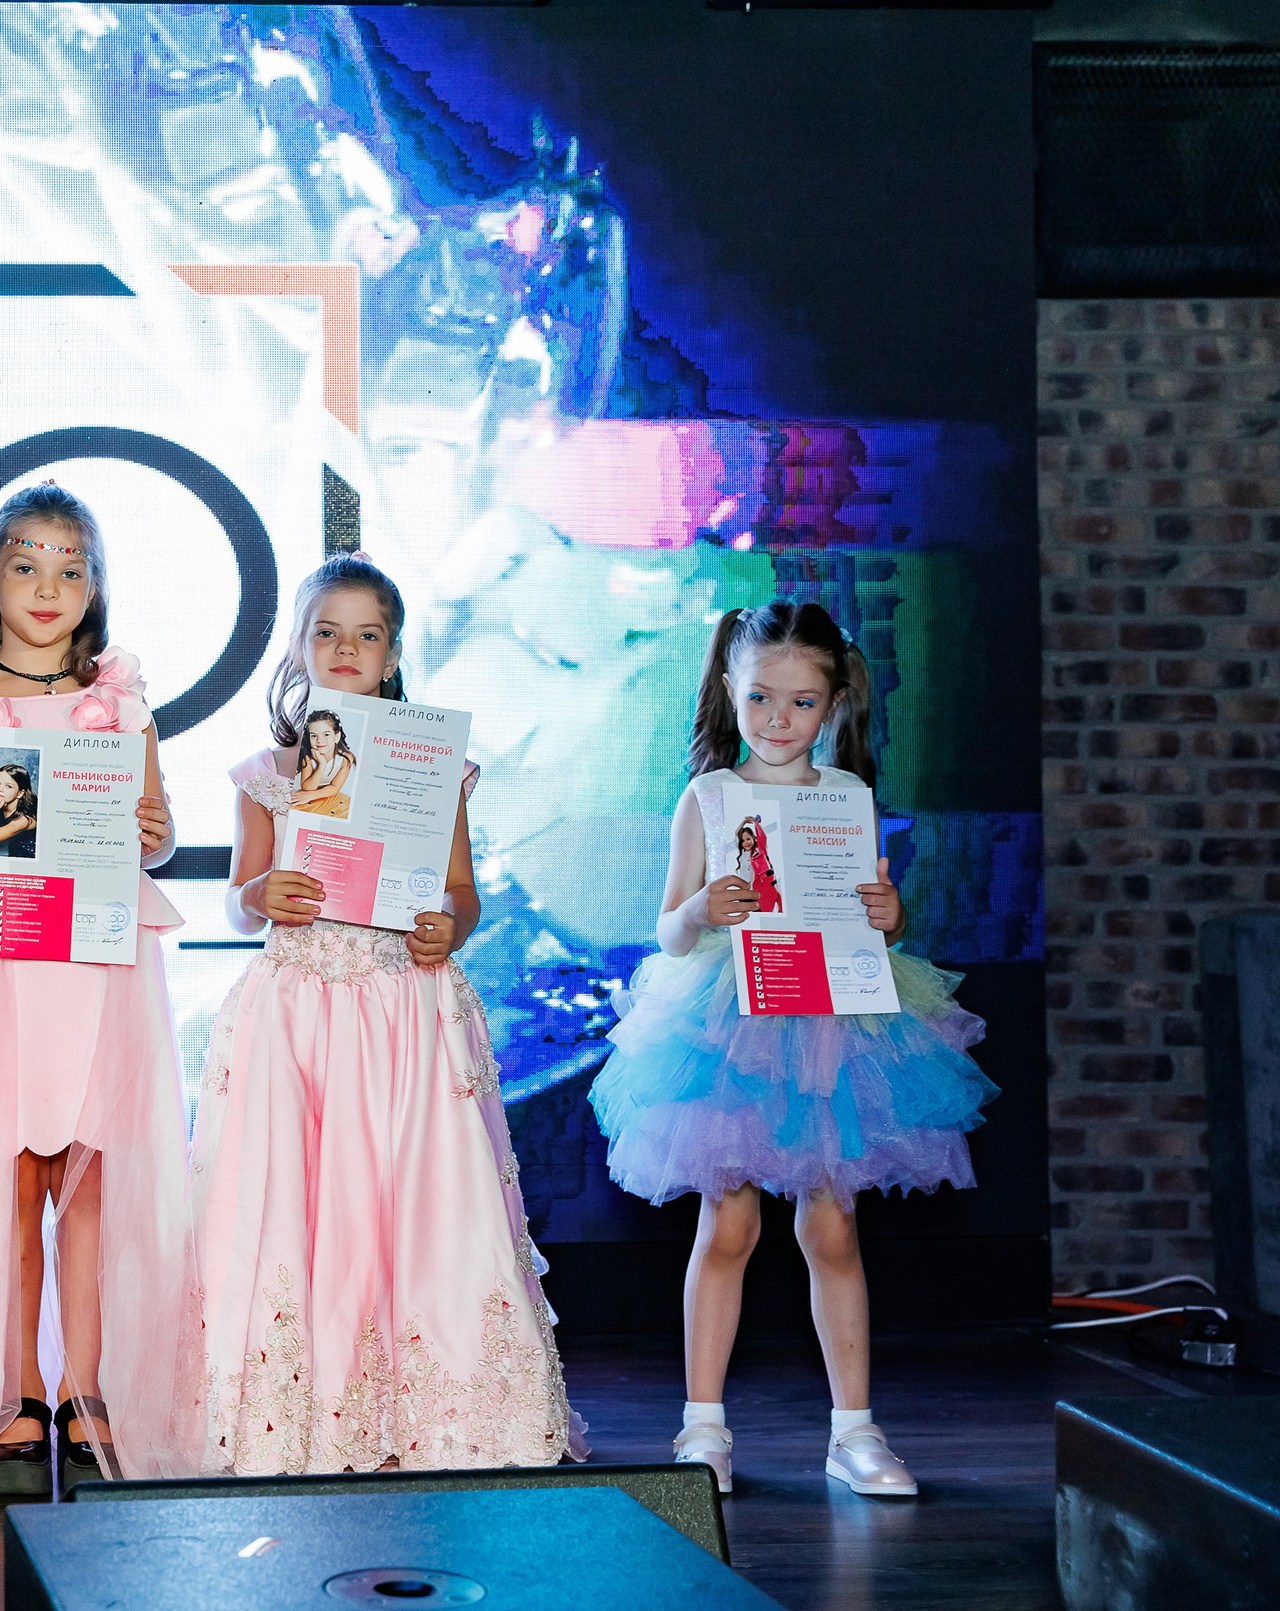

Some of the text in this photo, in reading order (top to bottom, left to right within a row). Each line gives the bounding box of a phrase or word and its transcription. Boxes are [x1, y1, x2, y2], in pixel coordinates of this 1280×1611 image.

[388, 706, 446, 723] ДИПЛОМ
[63, 737, 121, 749] ДИПЛОМ
[373, 736, 453, 756] МЕЛЬНИКОВОЙ
[390, 750, 436, 765] ВАРВАРЕ
[52, 770, 134, 783] МЕЛЬНИКОВОЙ
[71, 783, 111, 793] МАРИИ
[796, 792, 848, 802] ДИПЛОМ
[789, 824, 864, 836] АРТАМОНОВОЙ
[806, 837, 847, 846] ТАИСИИ
